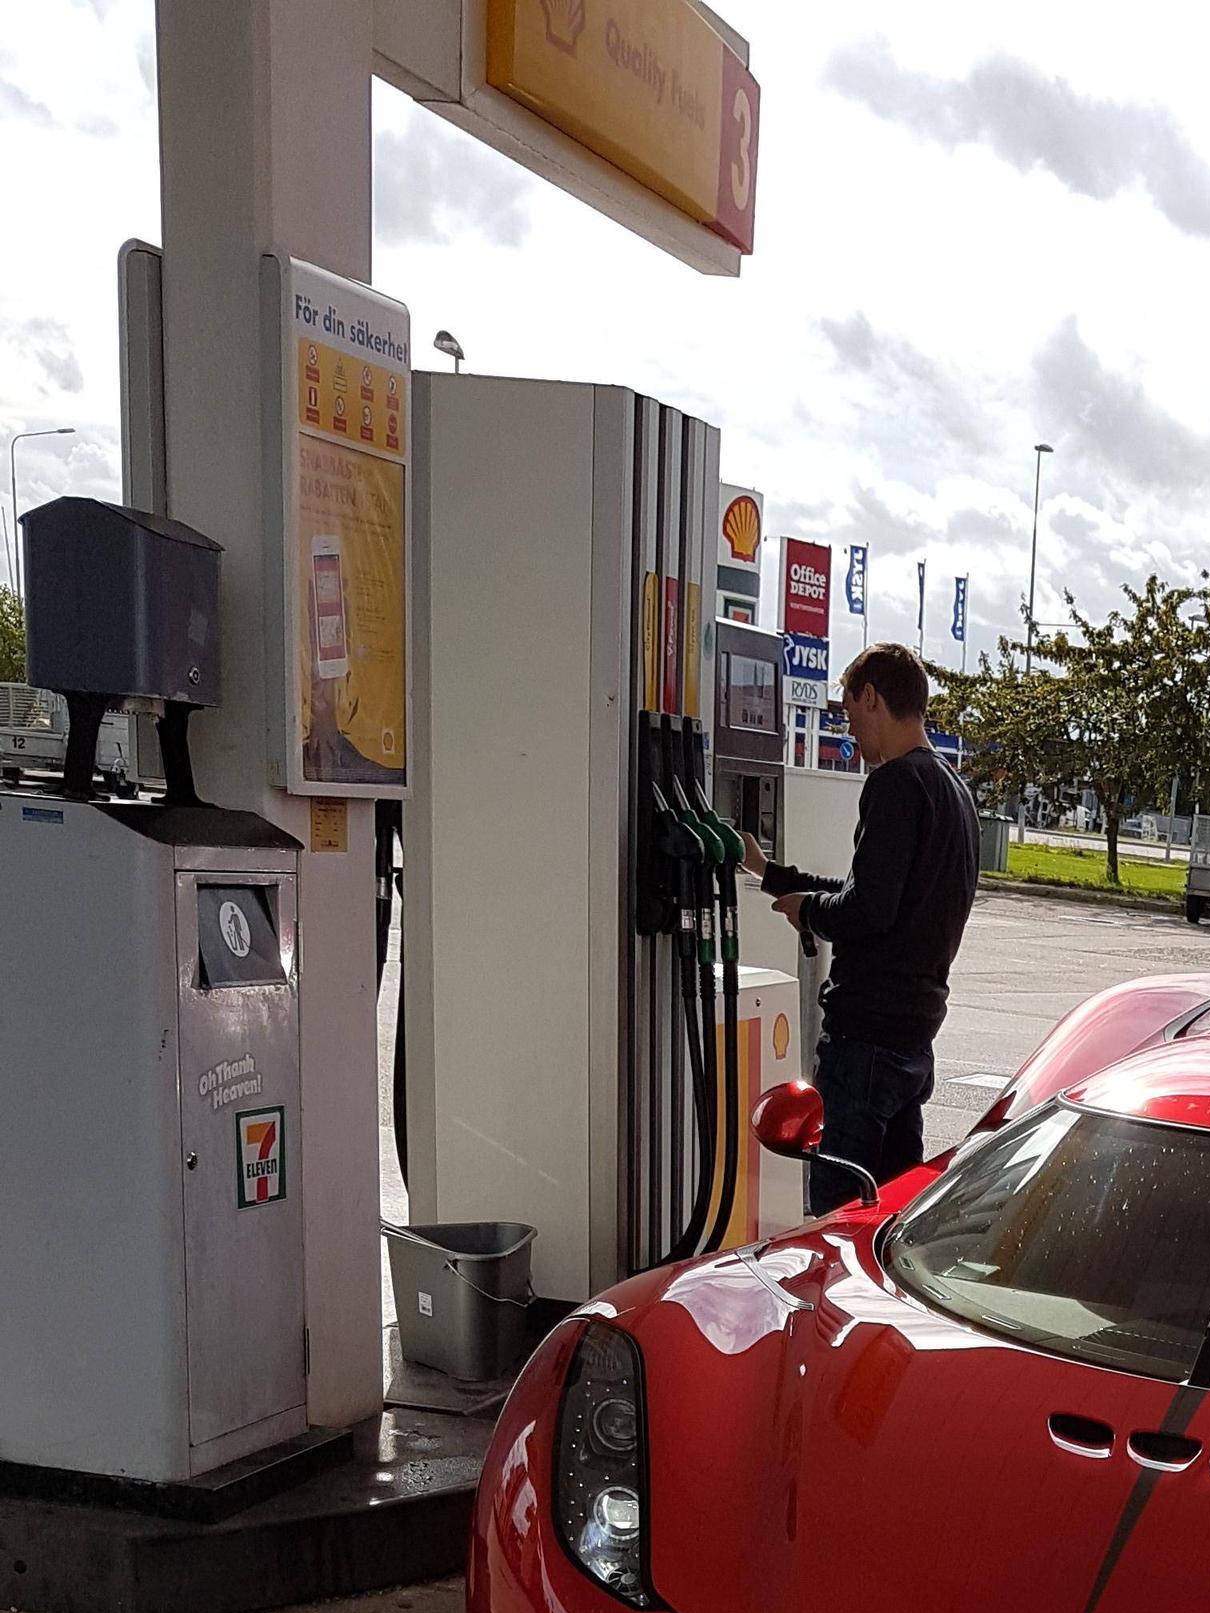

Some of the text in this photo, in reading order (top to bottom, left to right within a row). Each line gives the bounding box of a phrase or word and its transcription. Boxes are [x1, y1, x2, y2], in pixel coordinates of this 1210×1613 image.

[732, 88, 751, 211] 3
[295, 294, 319, 326] För
[323, 306, 346, 338] din
[790, 563, 827, 588] Office
[790, 581, 826, 600] DEPOT
[791, 645, 828, 671] JYSK
[12, 736, 26, 750] 12
[199, 1053, 255, 1096] Oh Thank
[213, 1075, 262, 1109] Heaven!
